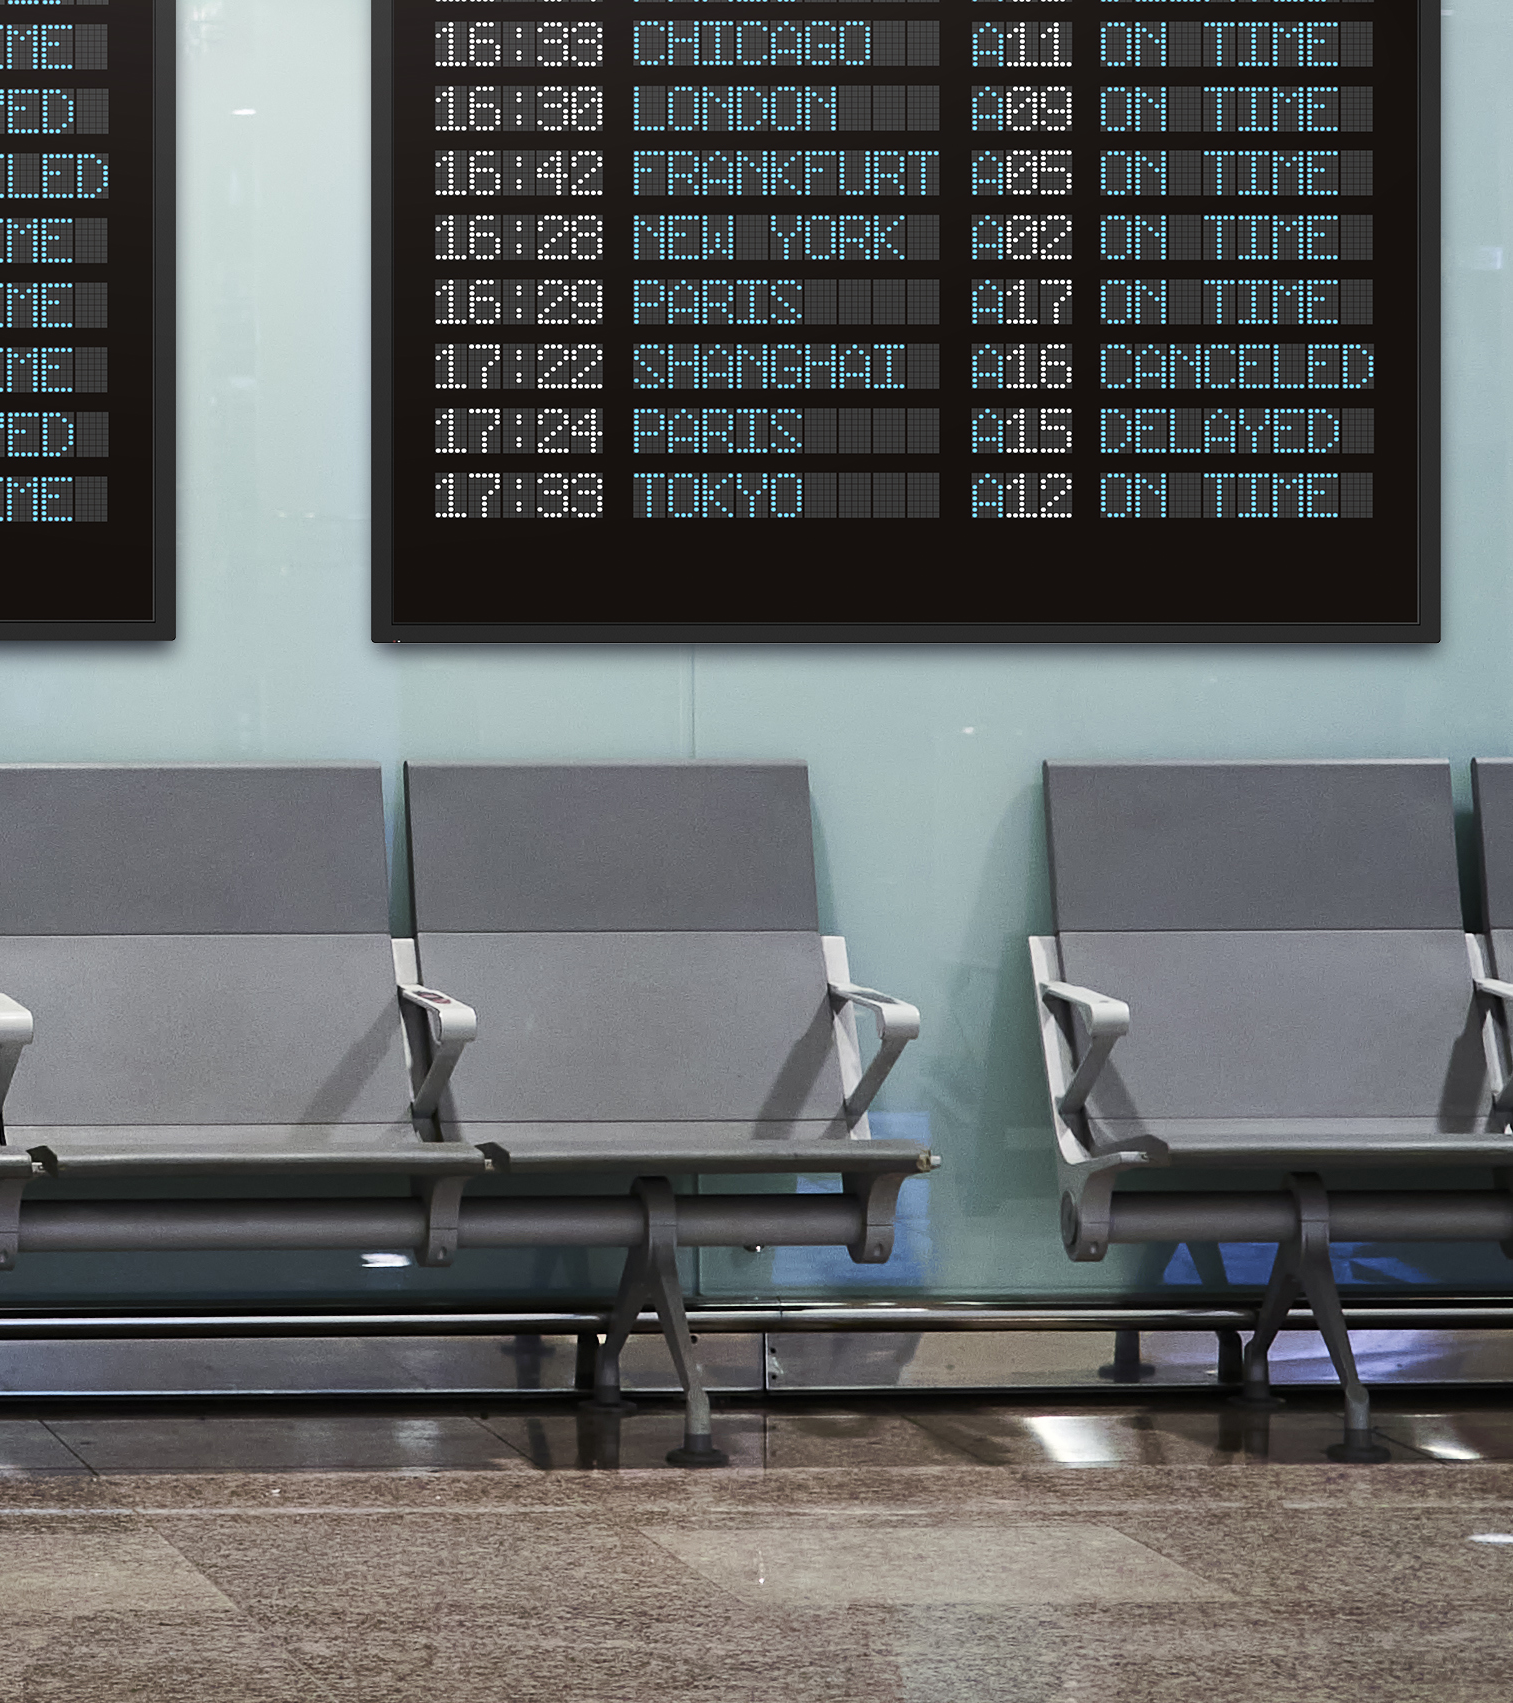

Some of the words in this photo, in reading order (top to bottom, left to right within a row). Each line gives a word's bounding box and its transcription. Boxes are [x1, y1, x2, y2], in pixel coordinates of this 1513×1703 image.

[436, 87, 602, 130] 16:30
[634, 87, 836, 130] LONDON
[972, 87, 1071, 130] A09
[1101, 87, 1166, 131] ON
[1204, 87, 1338, 131] TIME
[436, 216, 602, 259] 16:28
[634, 216, 733, 259] NEW
[771, 216, 904, 259] YORK
[972, 215, 1071, 259] A02
[1101, 216, 1166, 259] ON
[1204, 216, 1338, 259] TIME
[436, 345, 602, 388] 17:22
[634, 345, 904, 388] SHANGHAI
[972, 344, 1071, 388] A16
[1101, 345, 1373, 388] CANCELED
[436, 474, 602, 517] 17:33
[634, 474, 802, 517] TOKYO
[972, 474, 1071, 517] A12
[1101, 474, 1166, 517] ON
[1204, 474, 1338, 517] TIME
